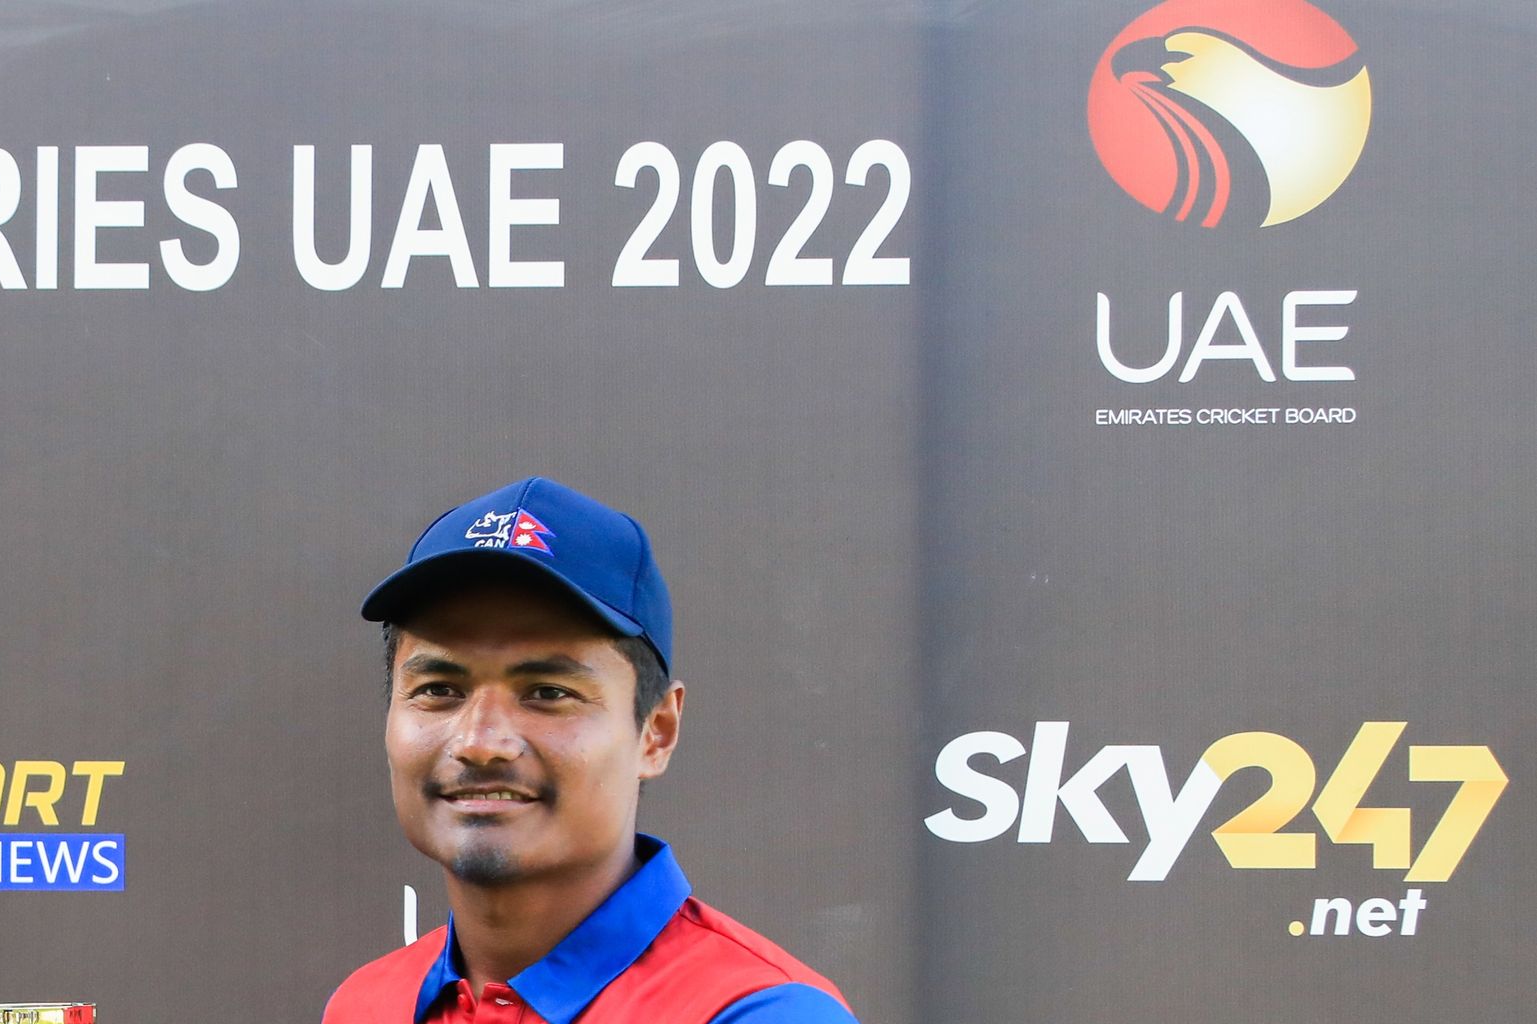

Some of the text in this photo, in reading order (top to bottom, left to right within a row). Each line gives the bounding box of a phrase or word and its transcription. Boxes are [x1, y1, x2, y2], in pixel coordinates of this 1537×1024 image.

[293, 144, 566, 292] UAE
[612, 139, 912, 290] 2022
[1097, 290, 1358, 384] UAE
[1095, 408, 1357, 426] EMIRATES CRICKET BOARD
[474, 538, 506, 549] CAN
[1288, 889, 1427, 938] .net
